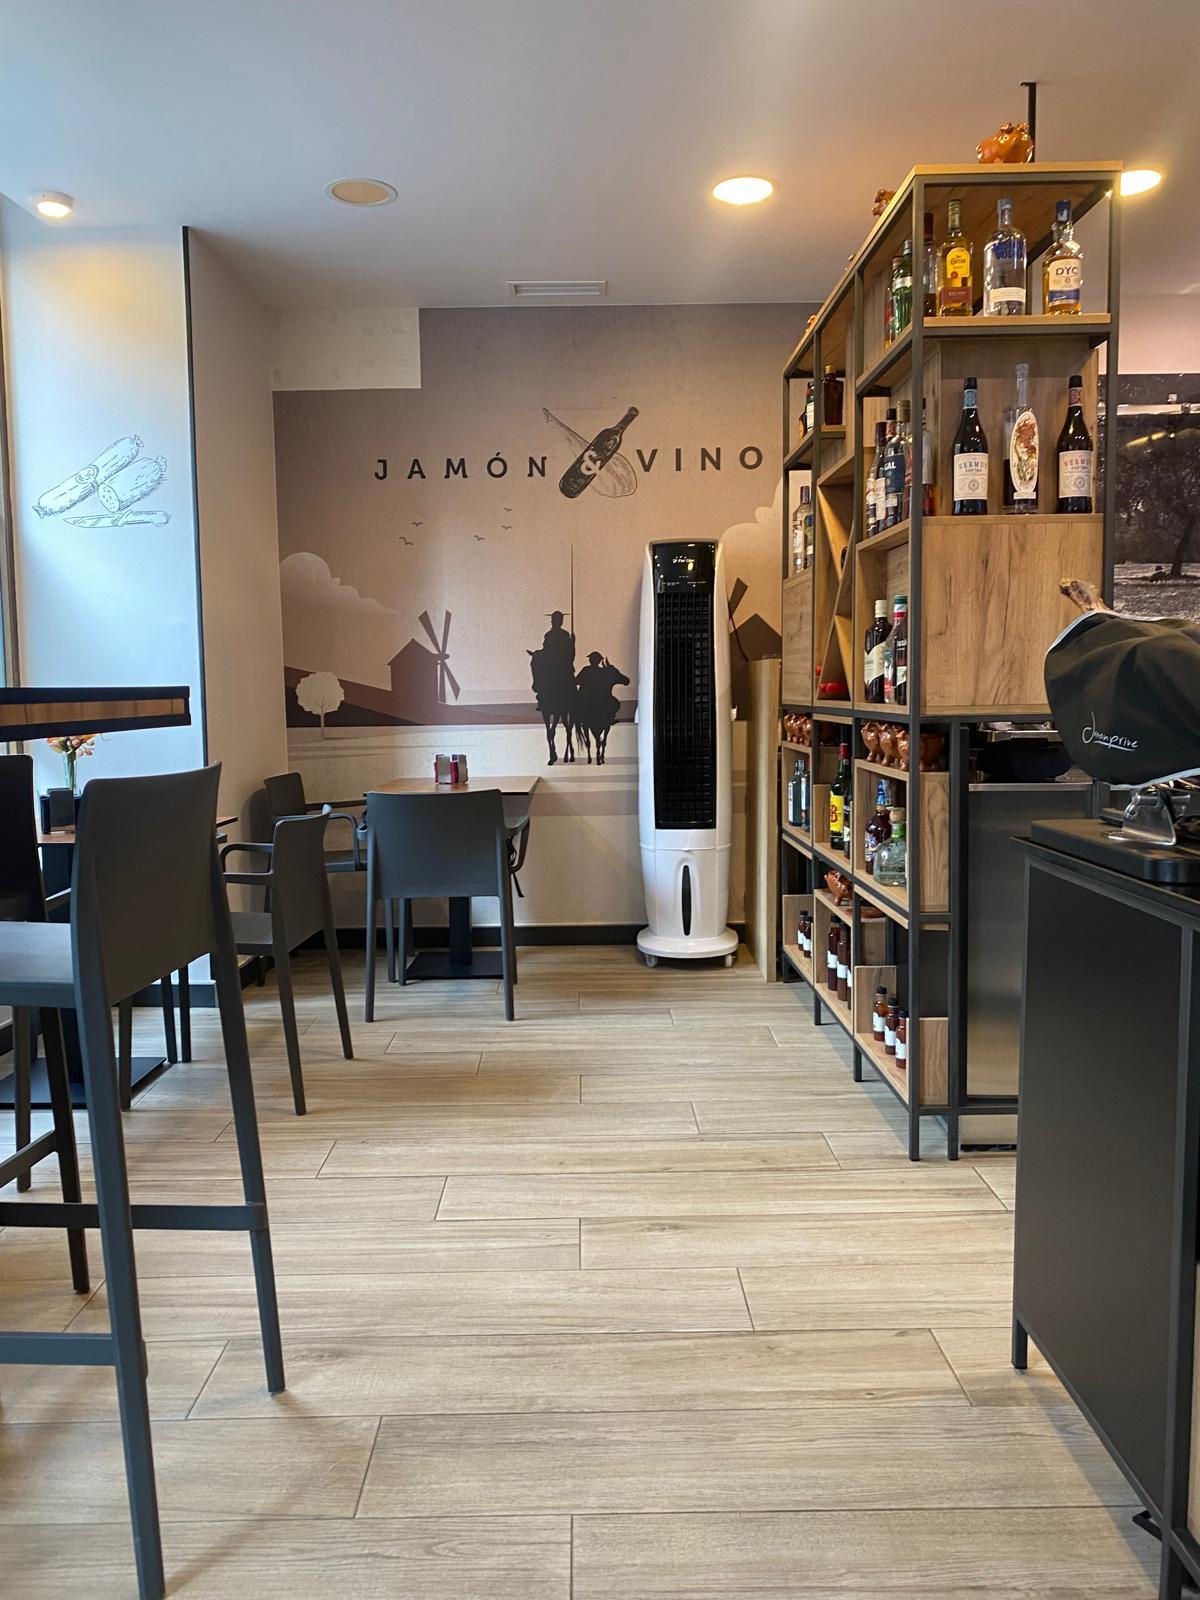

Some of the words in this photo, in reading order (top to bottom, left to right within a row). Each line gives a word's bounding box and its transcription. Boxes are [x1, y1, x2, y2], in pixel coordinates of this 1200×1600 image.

[1056, 266, 1079, 276] DYC
[373, 451, 548, 480] JAMÓN
[635, 445, 764, 473] VINO
